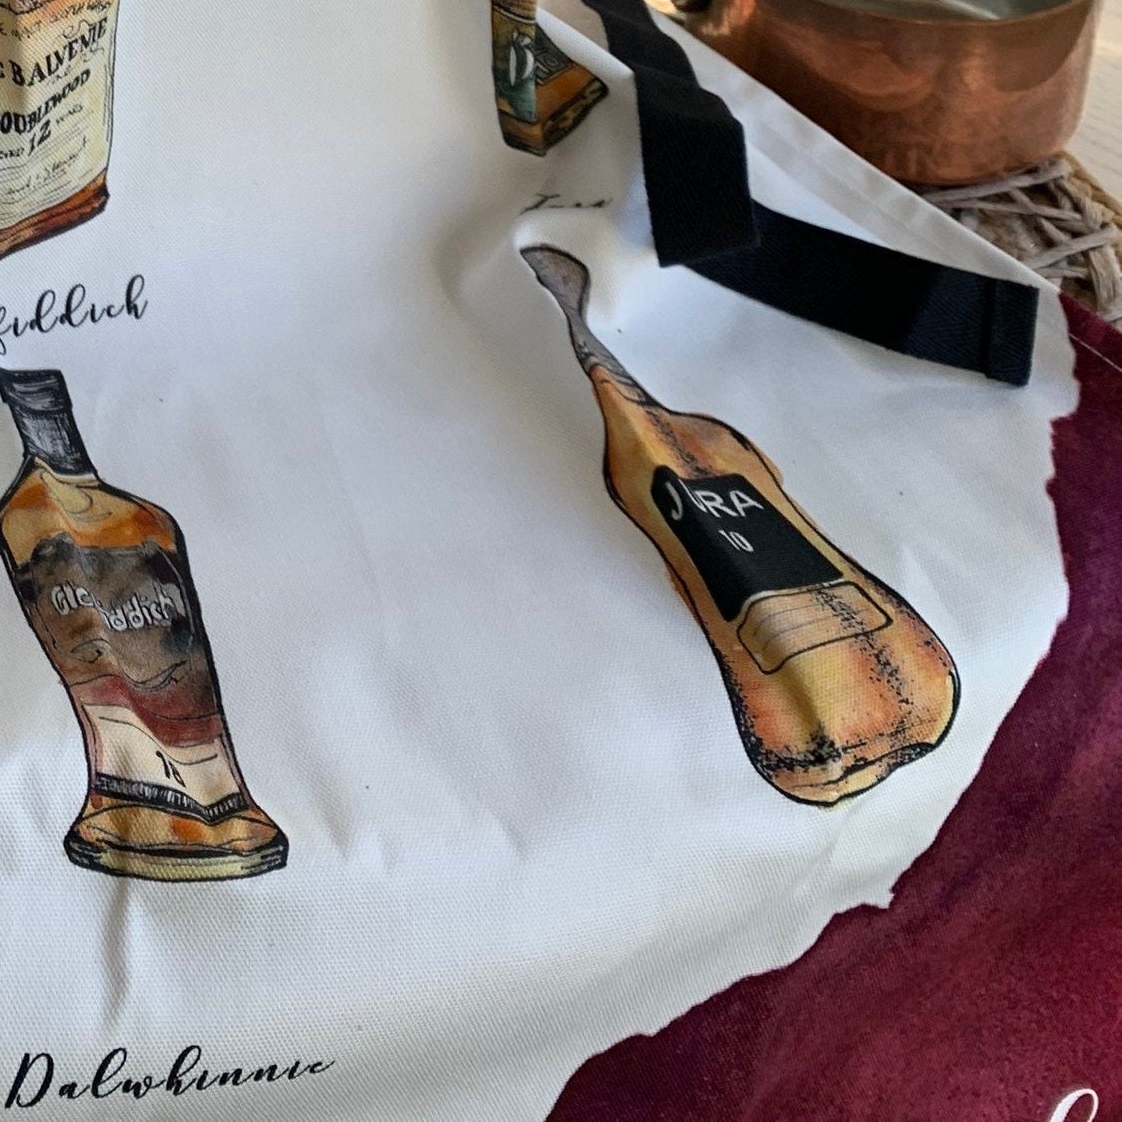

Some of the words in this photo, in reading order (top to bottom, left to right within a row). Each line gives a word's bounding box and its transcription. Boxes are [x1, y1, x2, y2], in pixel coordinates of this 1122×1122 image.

[9, 17, 108, 87] BALVENIE
[27, 119, 53, 157] 12
[718, 528, 755, 553] 10
[4, 1044, 336, 1109] Dalwhinnie
